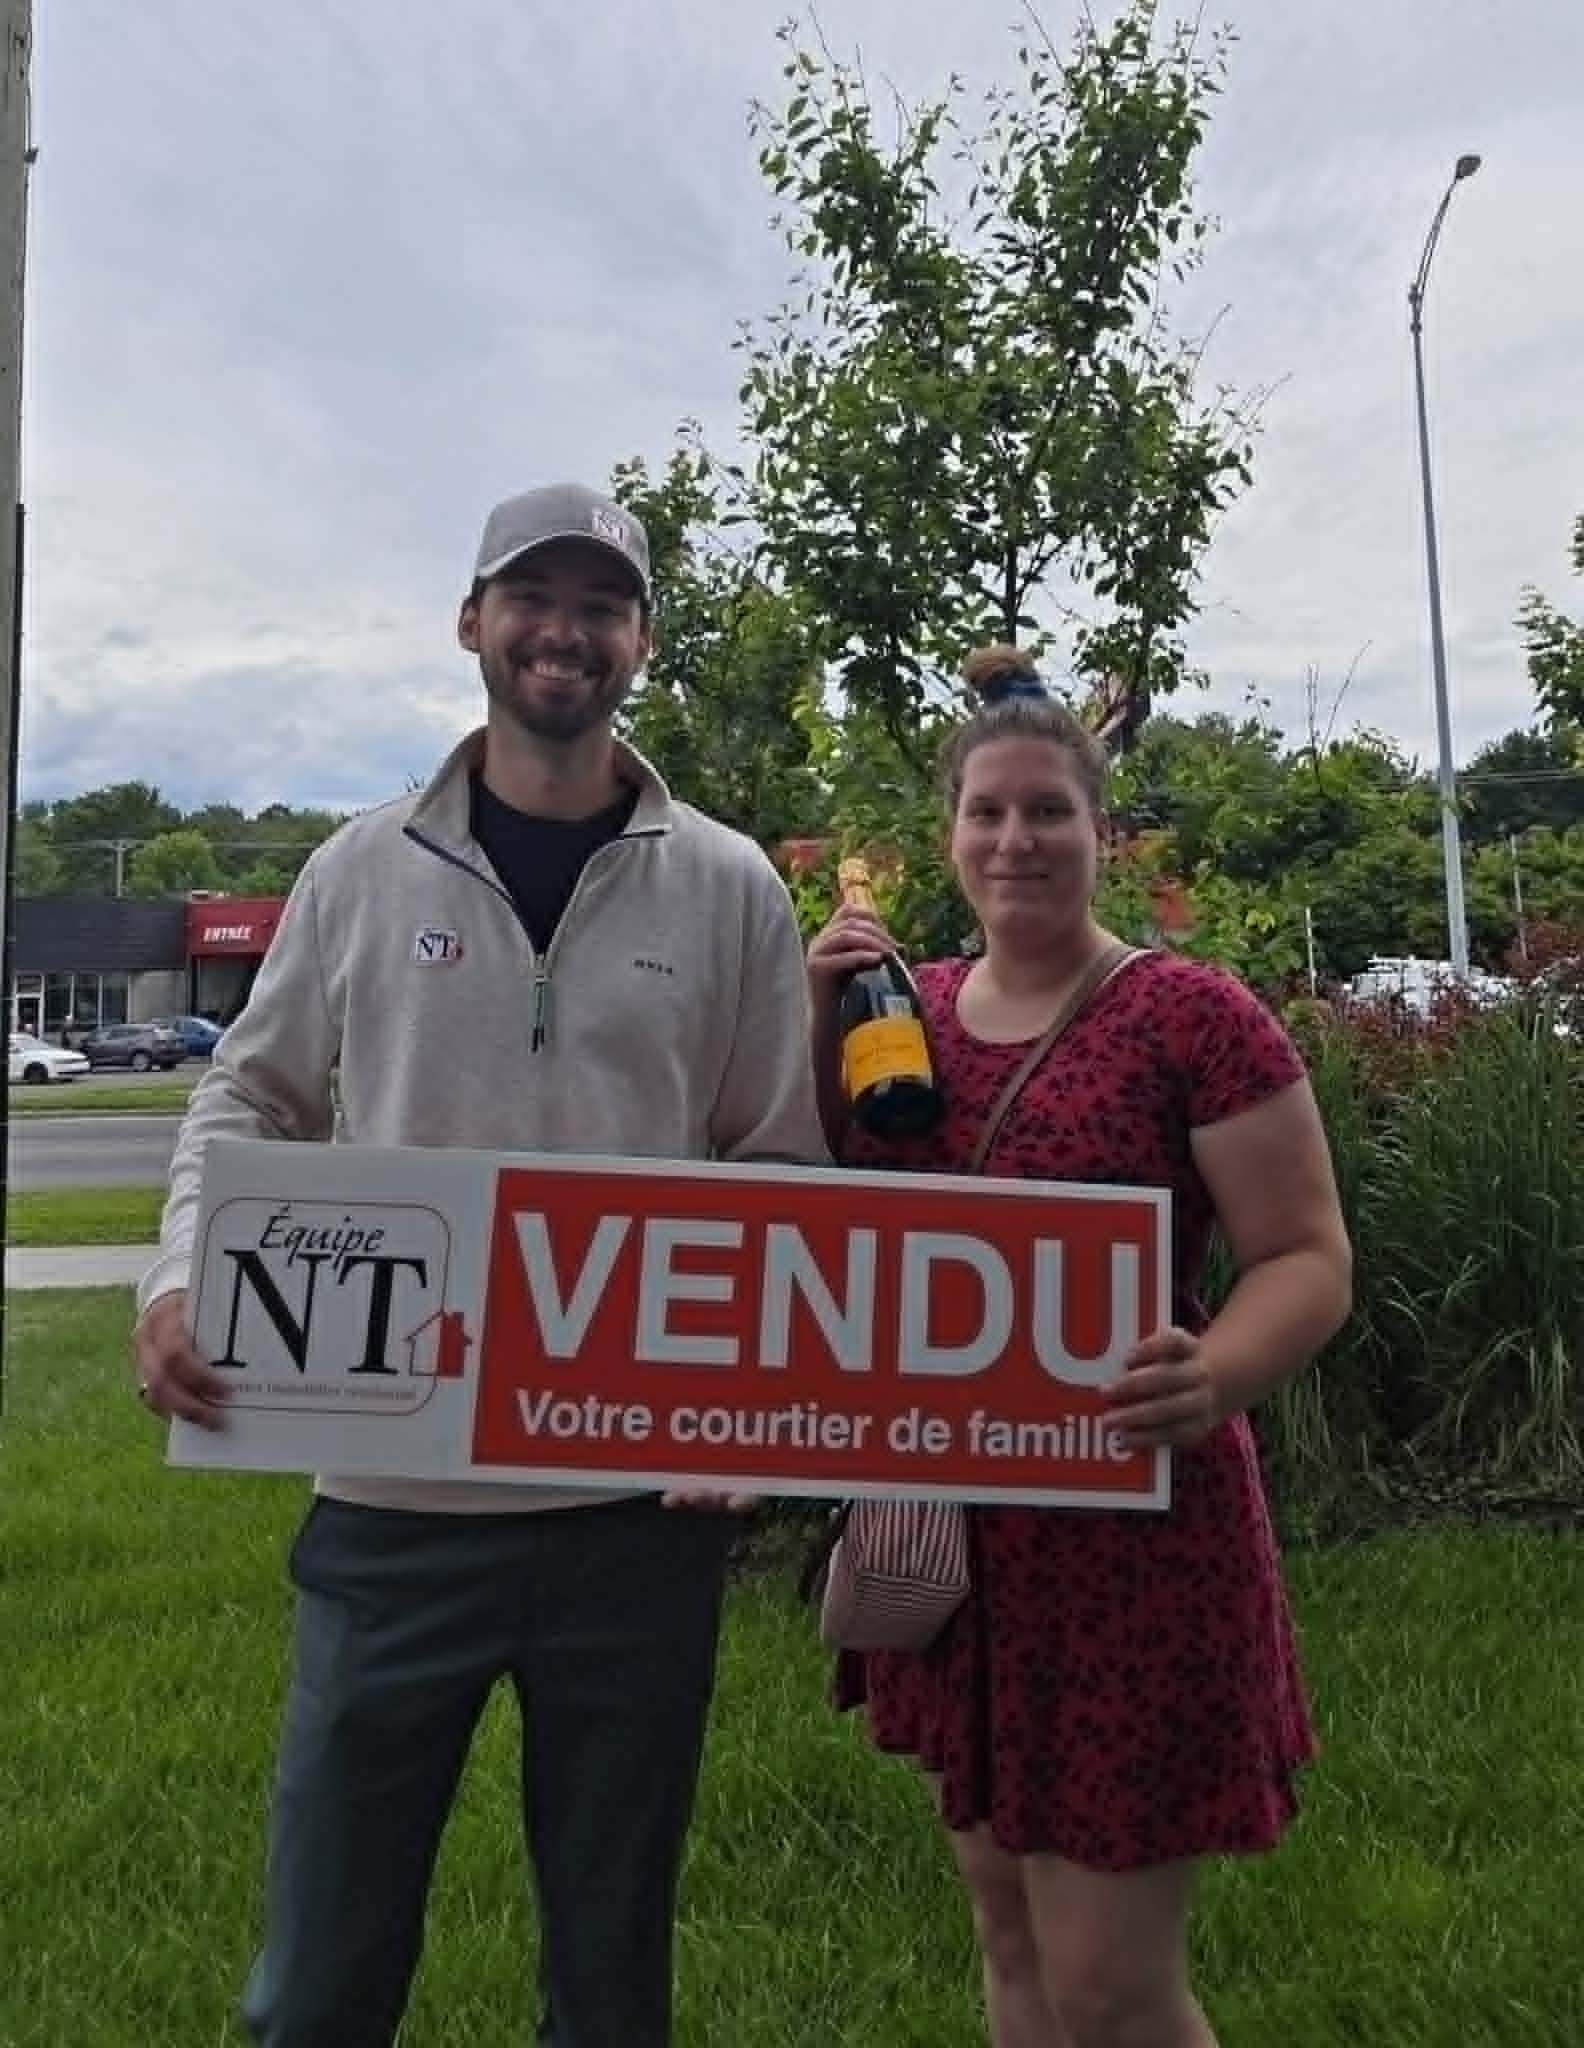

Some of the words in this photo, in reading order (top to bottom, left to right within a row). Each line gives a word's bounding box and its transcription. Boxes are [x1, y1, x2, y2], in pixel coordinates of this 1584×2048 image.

[416, 929, 450, 958] NT
[259, 1201, 385, 1269] Équipe
[208, 1249, 427, 1374] NT
[512, 1211, 1139, 1388] VENDU
[516, 1389, 650, 1440] Votre
[671, 1402, 872, 1449] courtier
[888, 1408, 952, 1455] de
[967, 1410, 1135, 1462] famille
